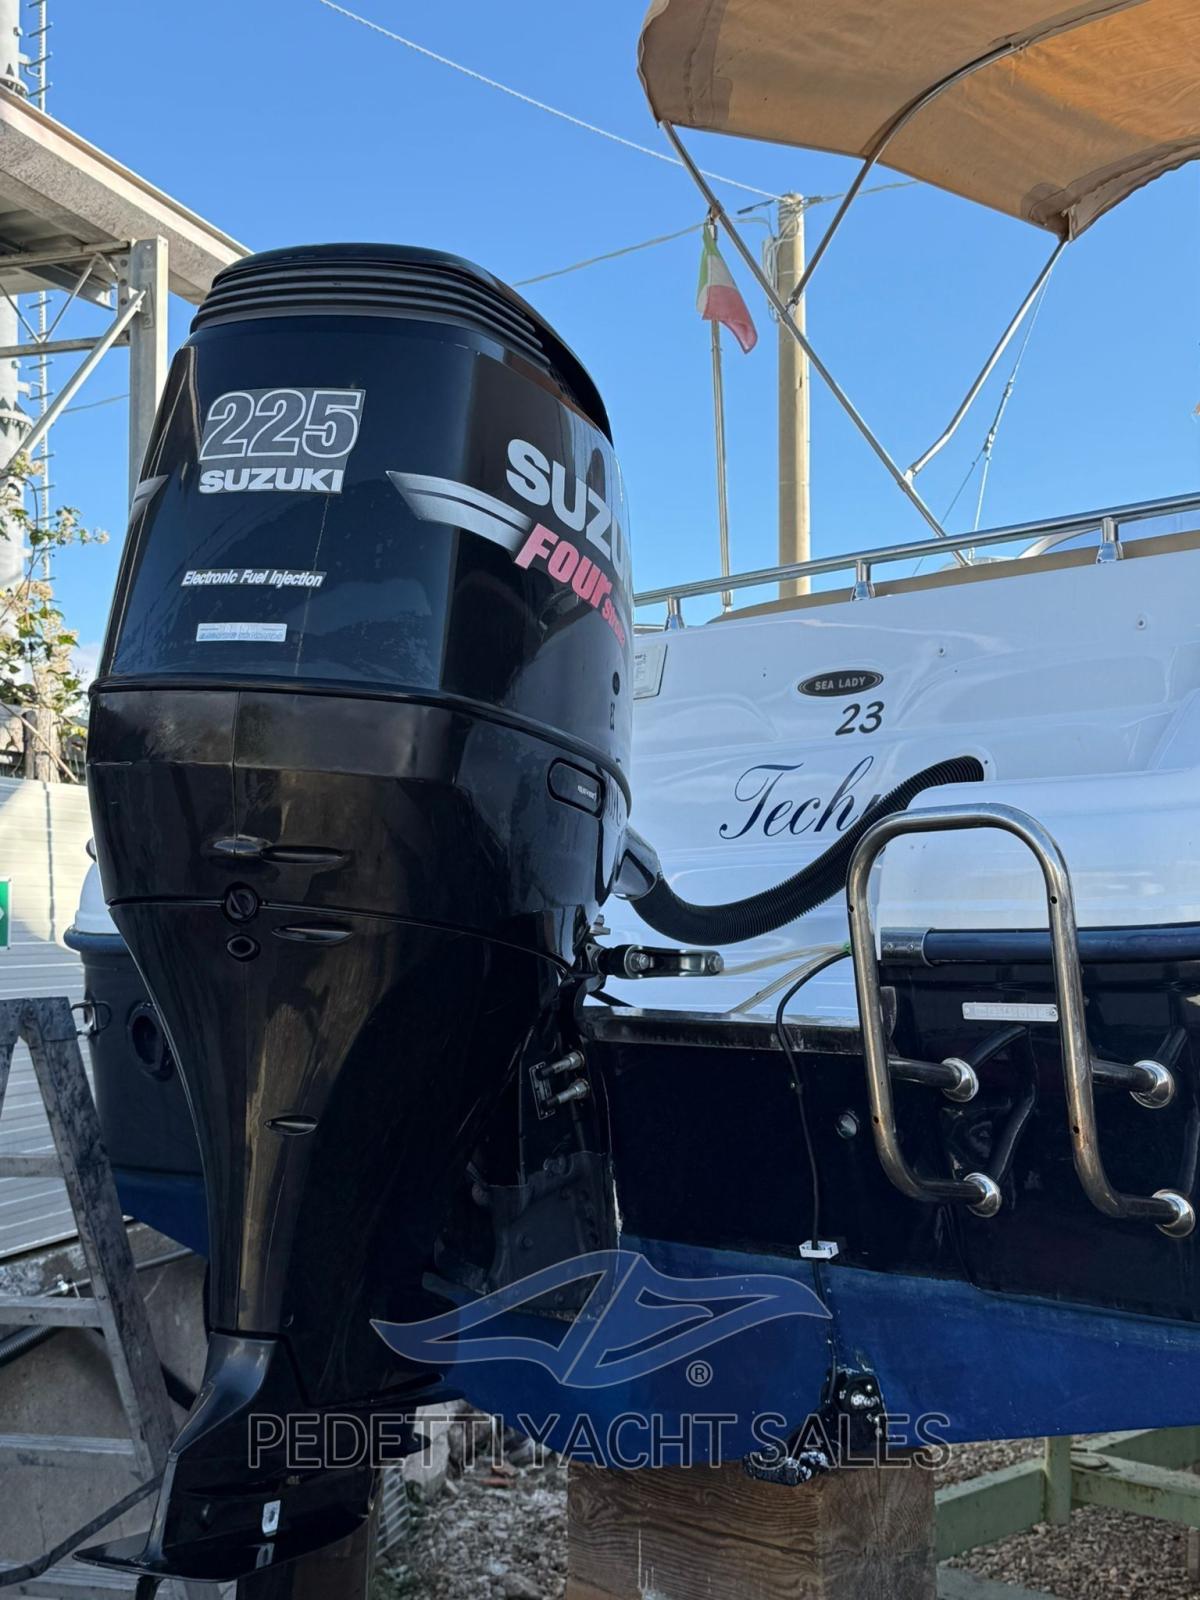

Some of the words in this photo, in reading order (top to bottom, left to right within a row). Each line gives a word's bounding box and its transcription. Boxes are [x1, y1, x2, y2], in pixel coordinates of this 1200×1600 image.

[200, 389, 362, 461] 225
[200, 467, 344, 494] SUZUKI
[182, 570, 237, 585] Electronic
[240, 570, 269, 584] Fuel
[269, 570, 324, 588] Injection
[814, 680, 834, 691] SEA
[839, 676, 866, 688] LADY
[835, 701, 885, 736] 23
